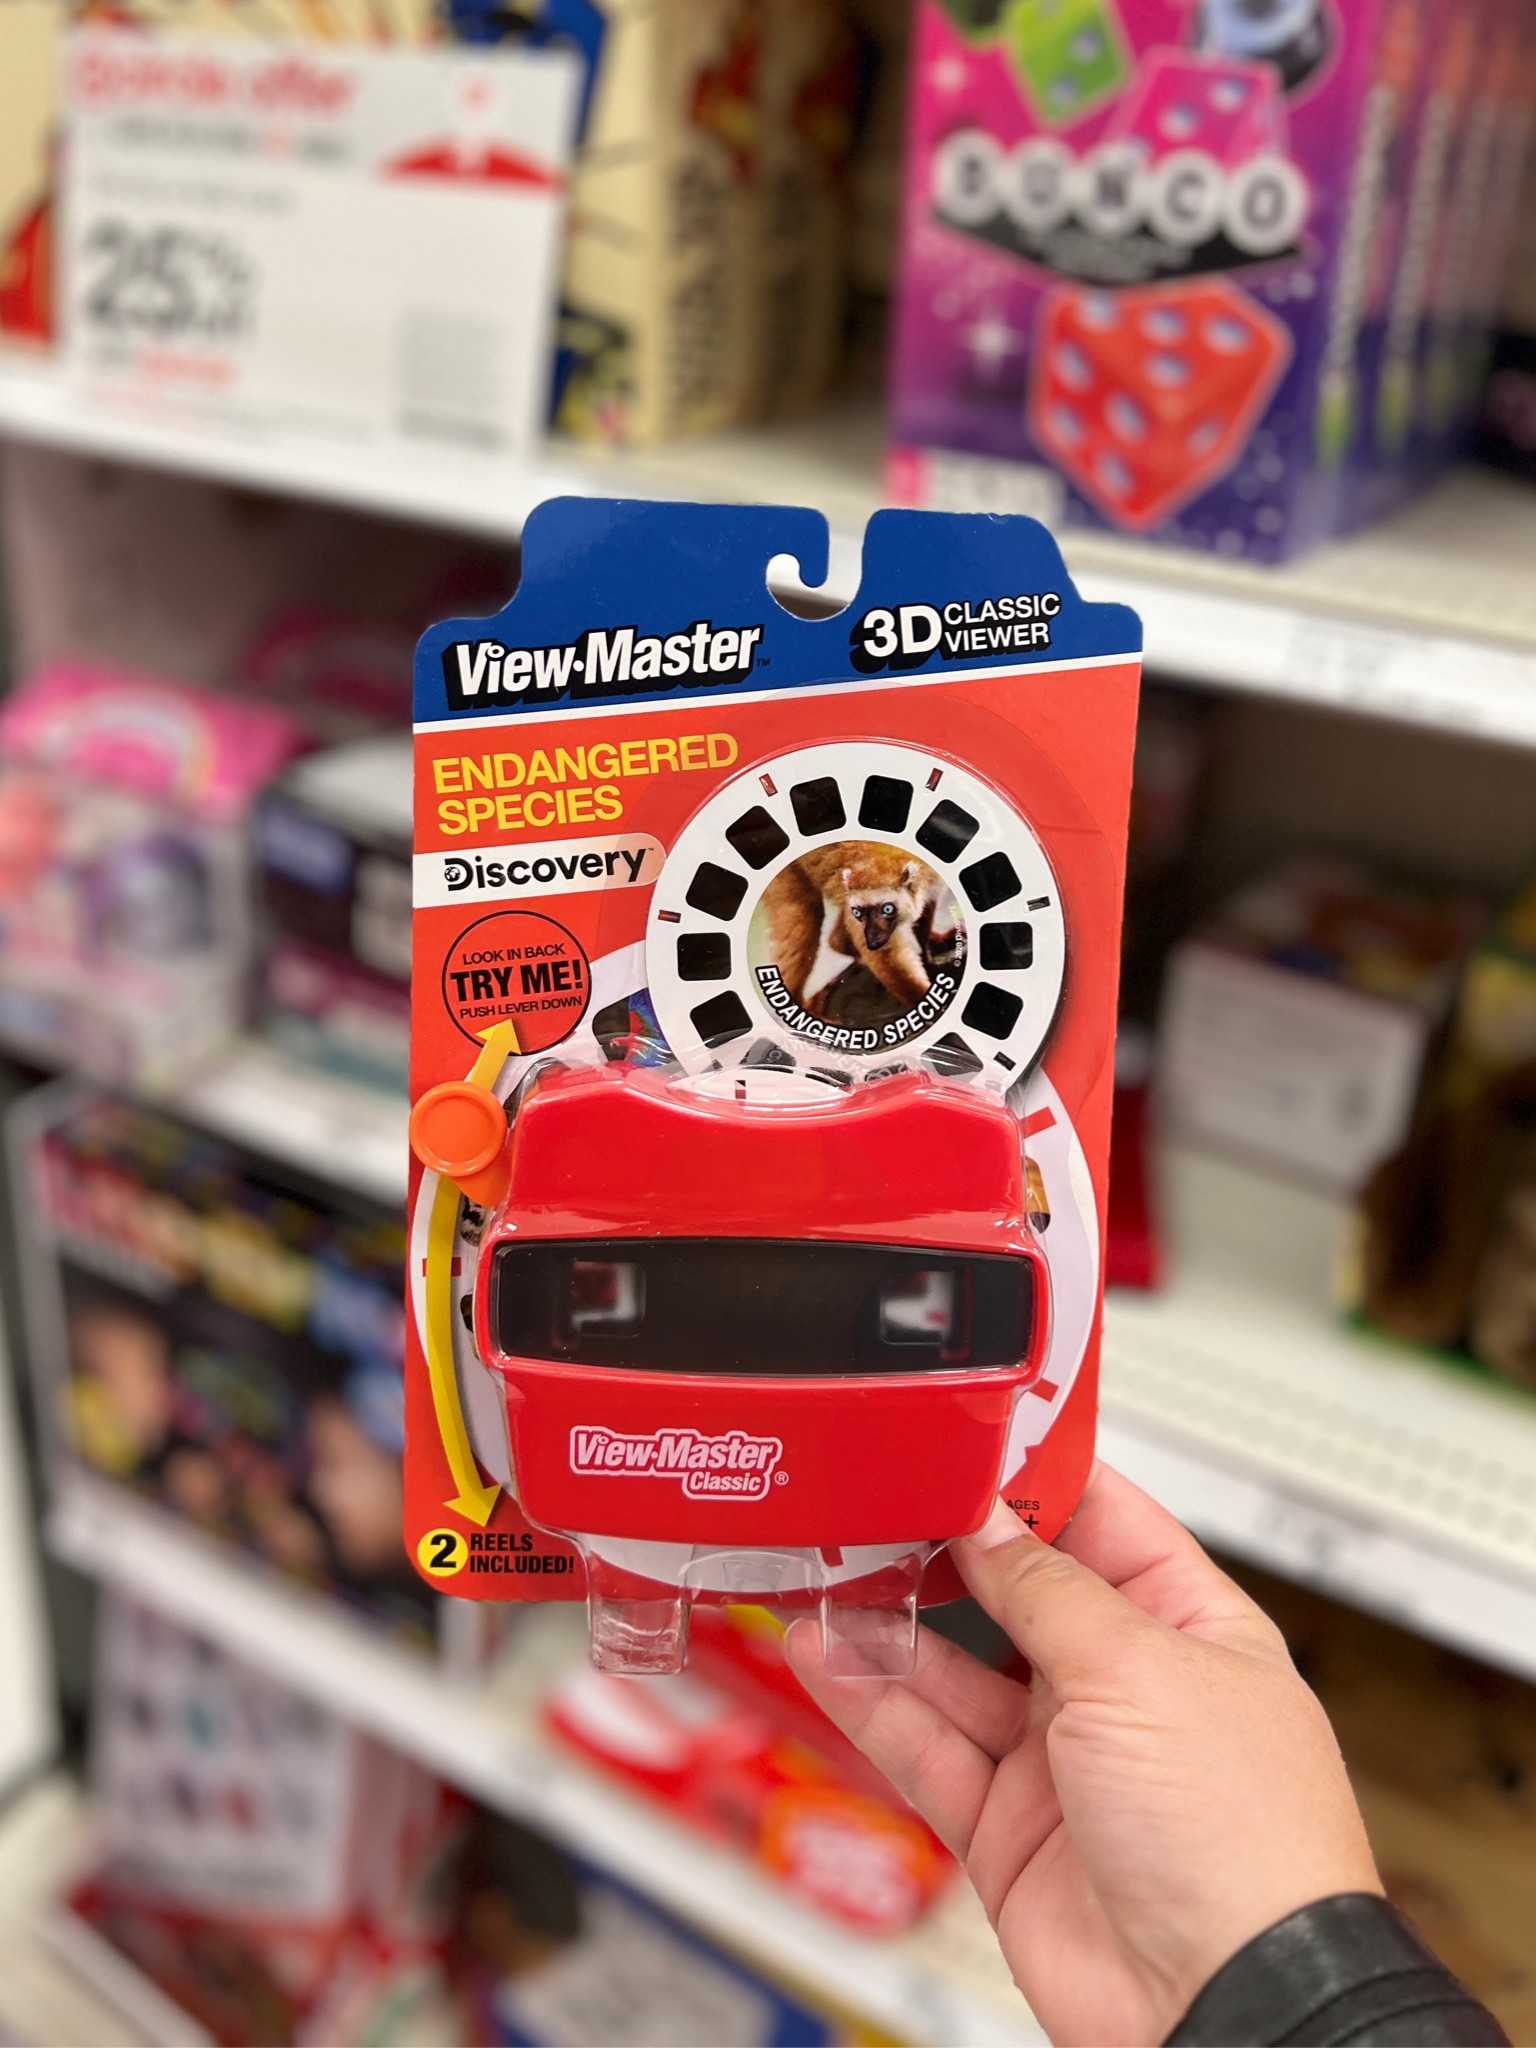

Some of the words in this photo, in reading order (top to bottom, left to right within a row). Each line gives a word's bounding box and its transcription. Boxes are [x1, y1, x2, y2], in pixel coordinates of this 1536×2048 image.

[944, 594, 1061, 625] CLASSIC
[862, 604, 943, 658] 3D
[945, 622, 1050, 653] VIEWER
[433, 732, 739, 794] ENDANGERED
[437, 785, 624, 835] SPECIES
[444, 847, 647, 892] Discovery
[462, 949, 504, 966] LOOK
[507, 947, 521, 960] IN
[525, 943, 566, 959] BACK
[450, 966, 514, 1002] TRY
[520, 959, 583, 995] ME!
[460, 1005, 496, 1019] PUSH
[498, 1000, 539, 1014] LEVER
[541, 996, 583, 1010] DOWN
[757, 965, 878, 1049] ENDANGERED
[884, 972, 956, 1044] SPECIES
[689, 1472, 762, 1492] Classic
[1005, 1499, 1040, 1511] AGES
[429, 1533, 458, 1569] 2
[470, 1533, 534, 1552] REELS
[469, 1555, 575, 1574] INCLUDED!
